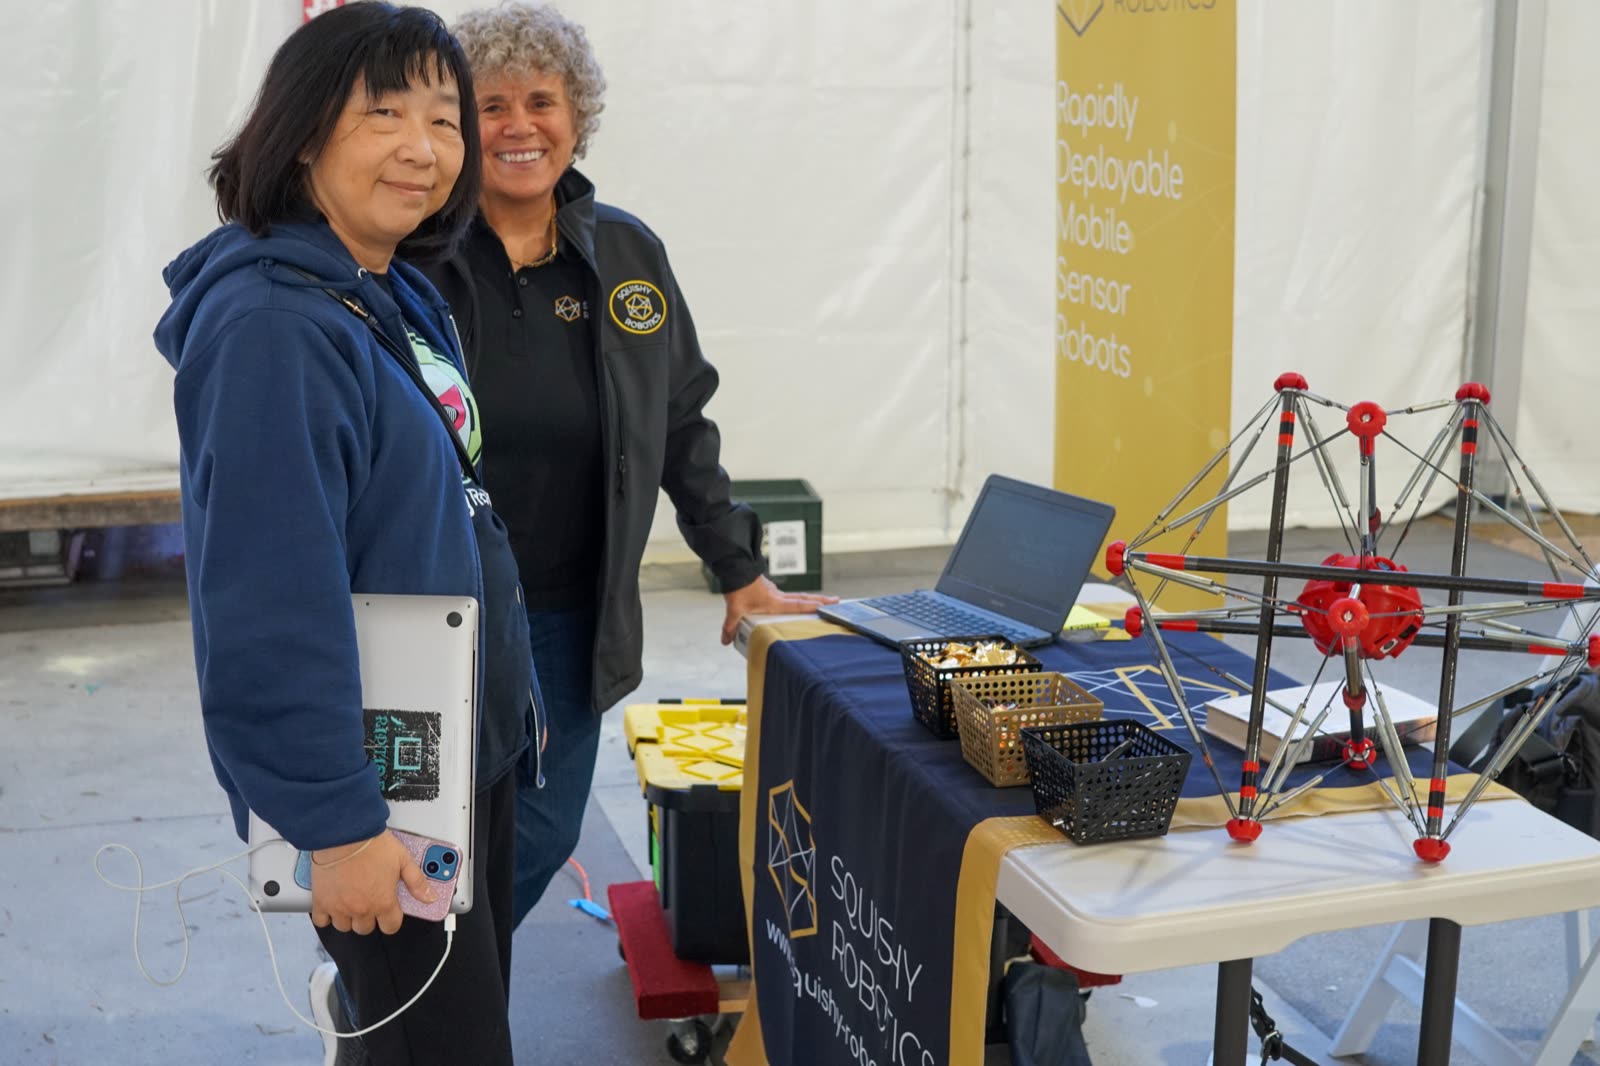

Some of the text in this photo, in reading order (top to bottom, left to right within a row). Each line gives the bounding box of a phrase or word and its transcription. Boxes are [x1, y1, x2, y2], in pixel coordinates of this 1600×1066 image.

[1056, 80, 1139, 143] Rapidly
[1057, 139, 1184, 204] Deployable
[1056, 200, 1131, 254] Mobile
[617, 285, 651, 300] SQUISHY
[1056, 255, 1132, 316] Sensor
[625, 313, 661, 330] ROBOTICS
[1055, 313, 1131, 378] Robots
